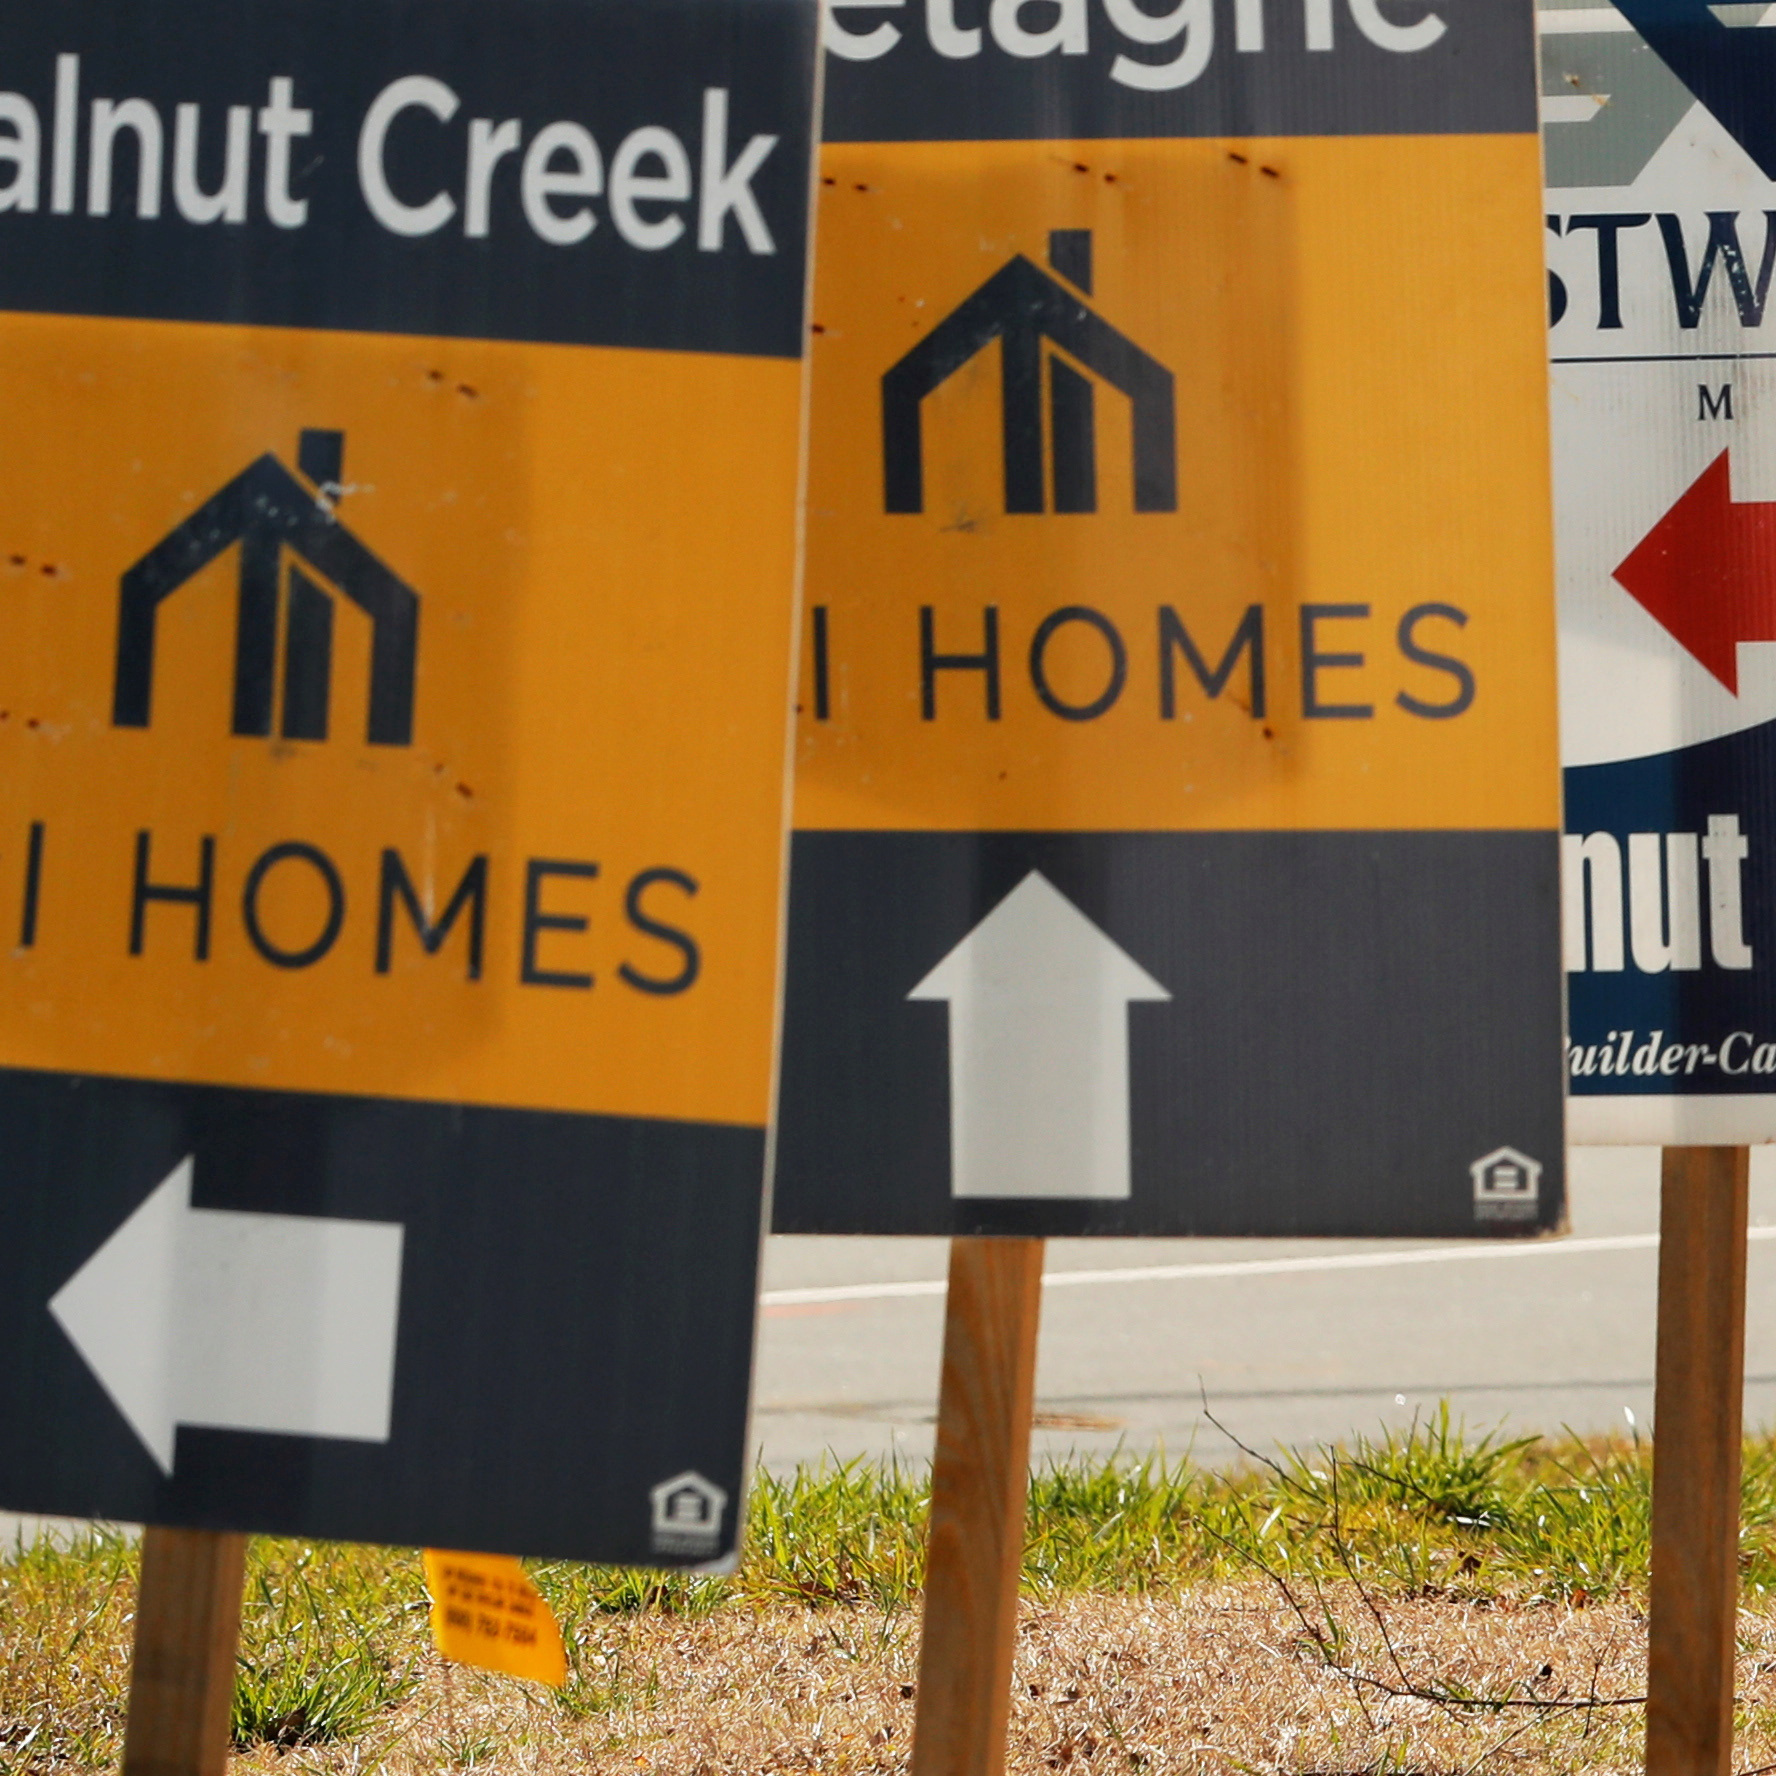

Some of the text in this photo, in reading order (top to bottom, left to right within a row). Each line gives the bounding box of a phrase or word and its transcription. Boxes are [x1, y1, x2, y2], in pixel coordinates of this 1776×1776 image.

[357, 75, 779, 255] Creek
[919, 602, 1477, 723] HOMES
[128, 829, 702, 997] HOMES
[1563, 812, 1753, 975] nut
